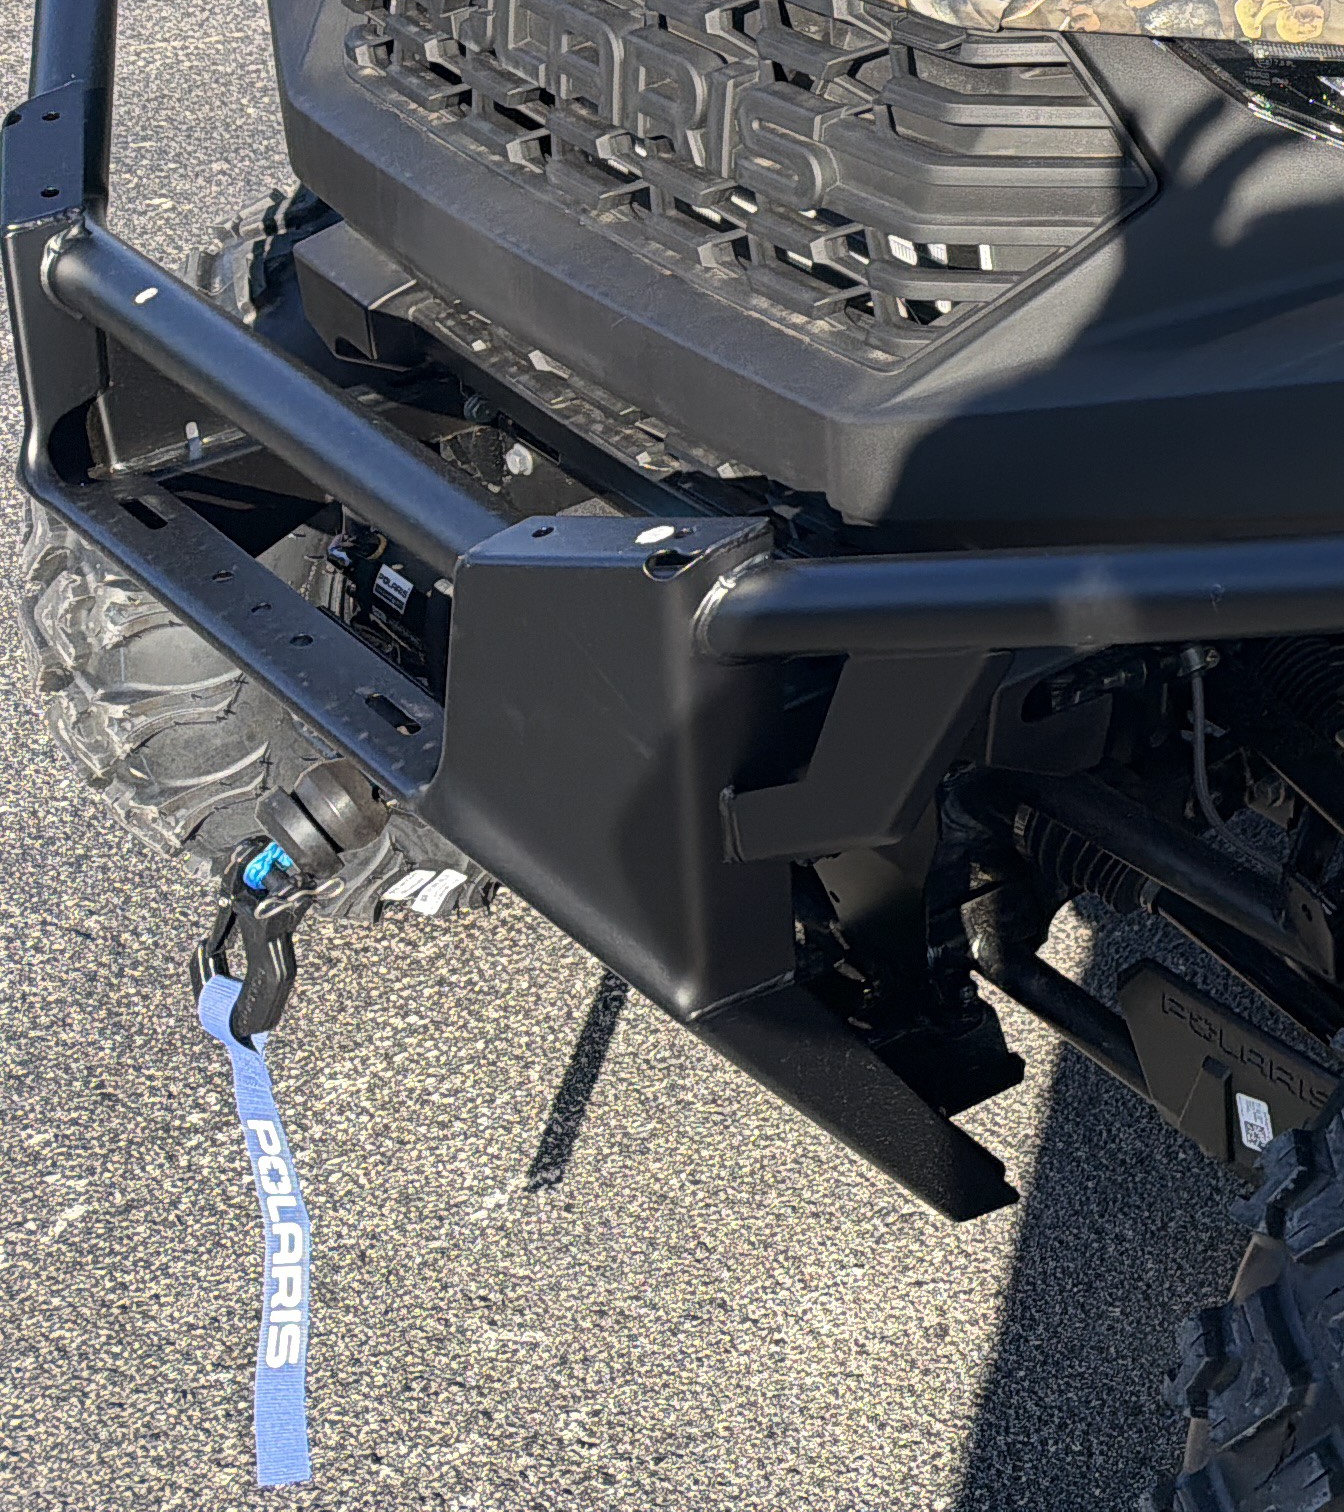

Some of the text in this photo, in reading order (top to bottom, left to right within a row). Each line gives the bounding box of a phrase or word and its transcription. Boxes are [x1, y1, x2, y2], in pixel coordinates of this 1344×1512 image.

[378, 572, 409, 599] POLARIS
[1160, 991, 1330, 1112] POLARIS
[247, 1119, 303, 1369] POLARIS
